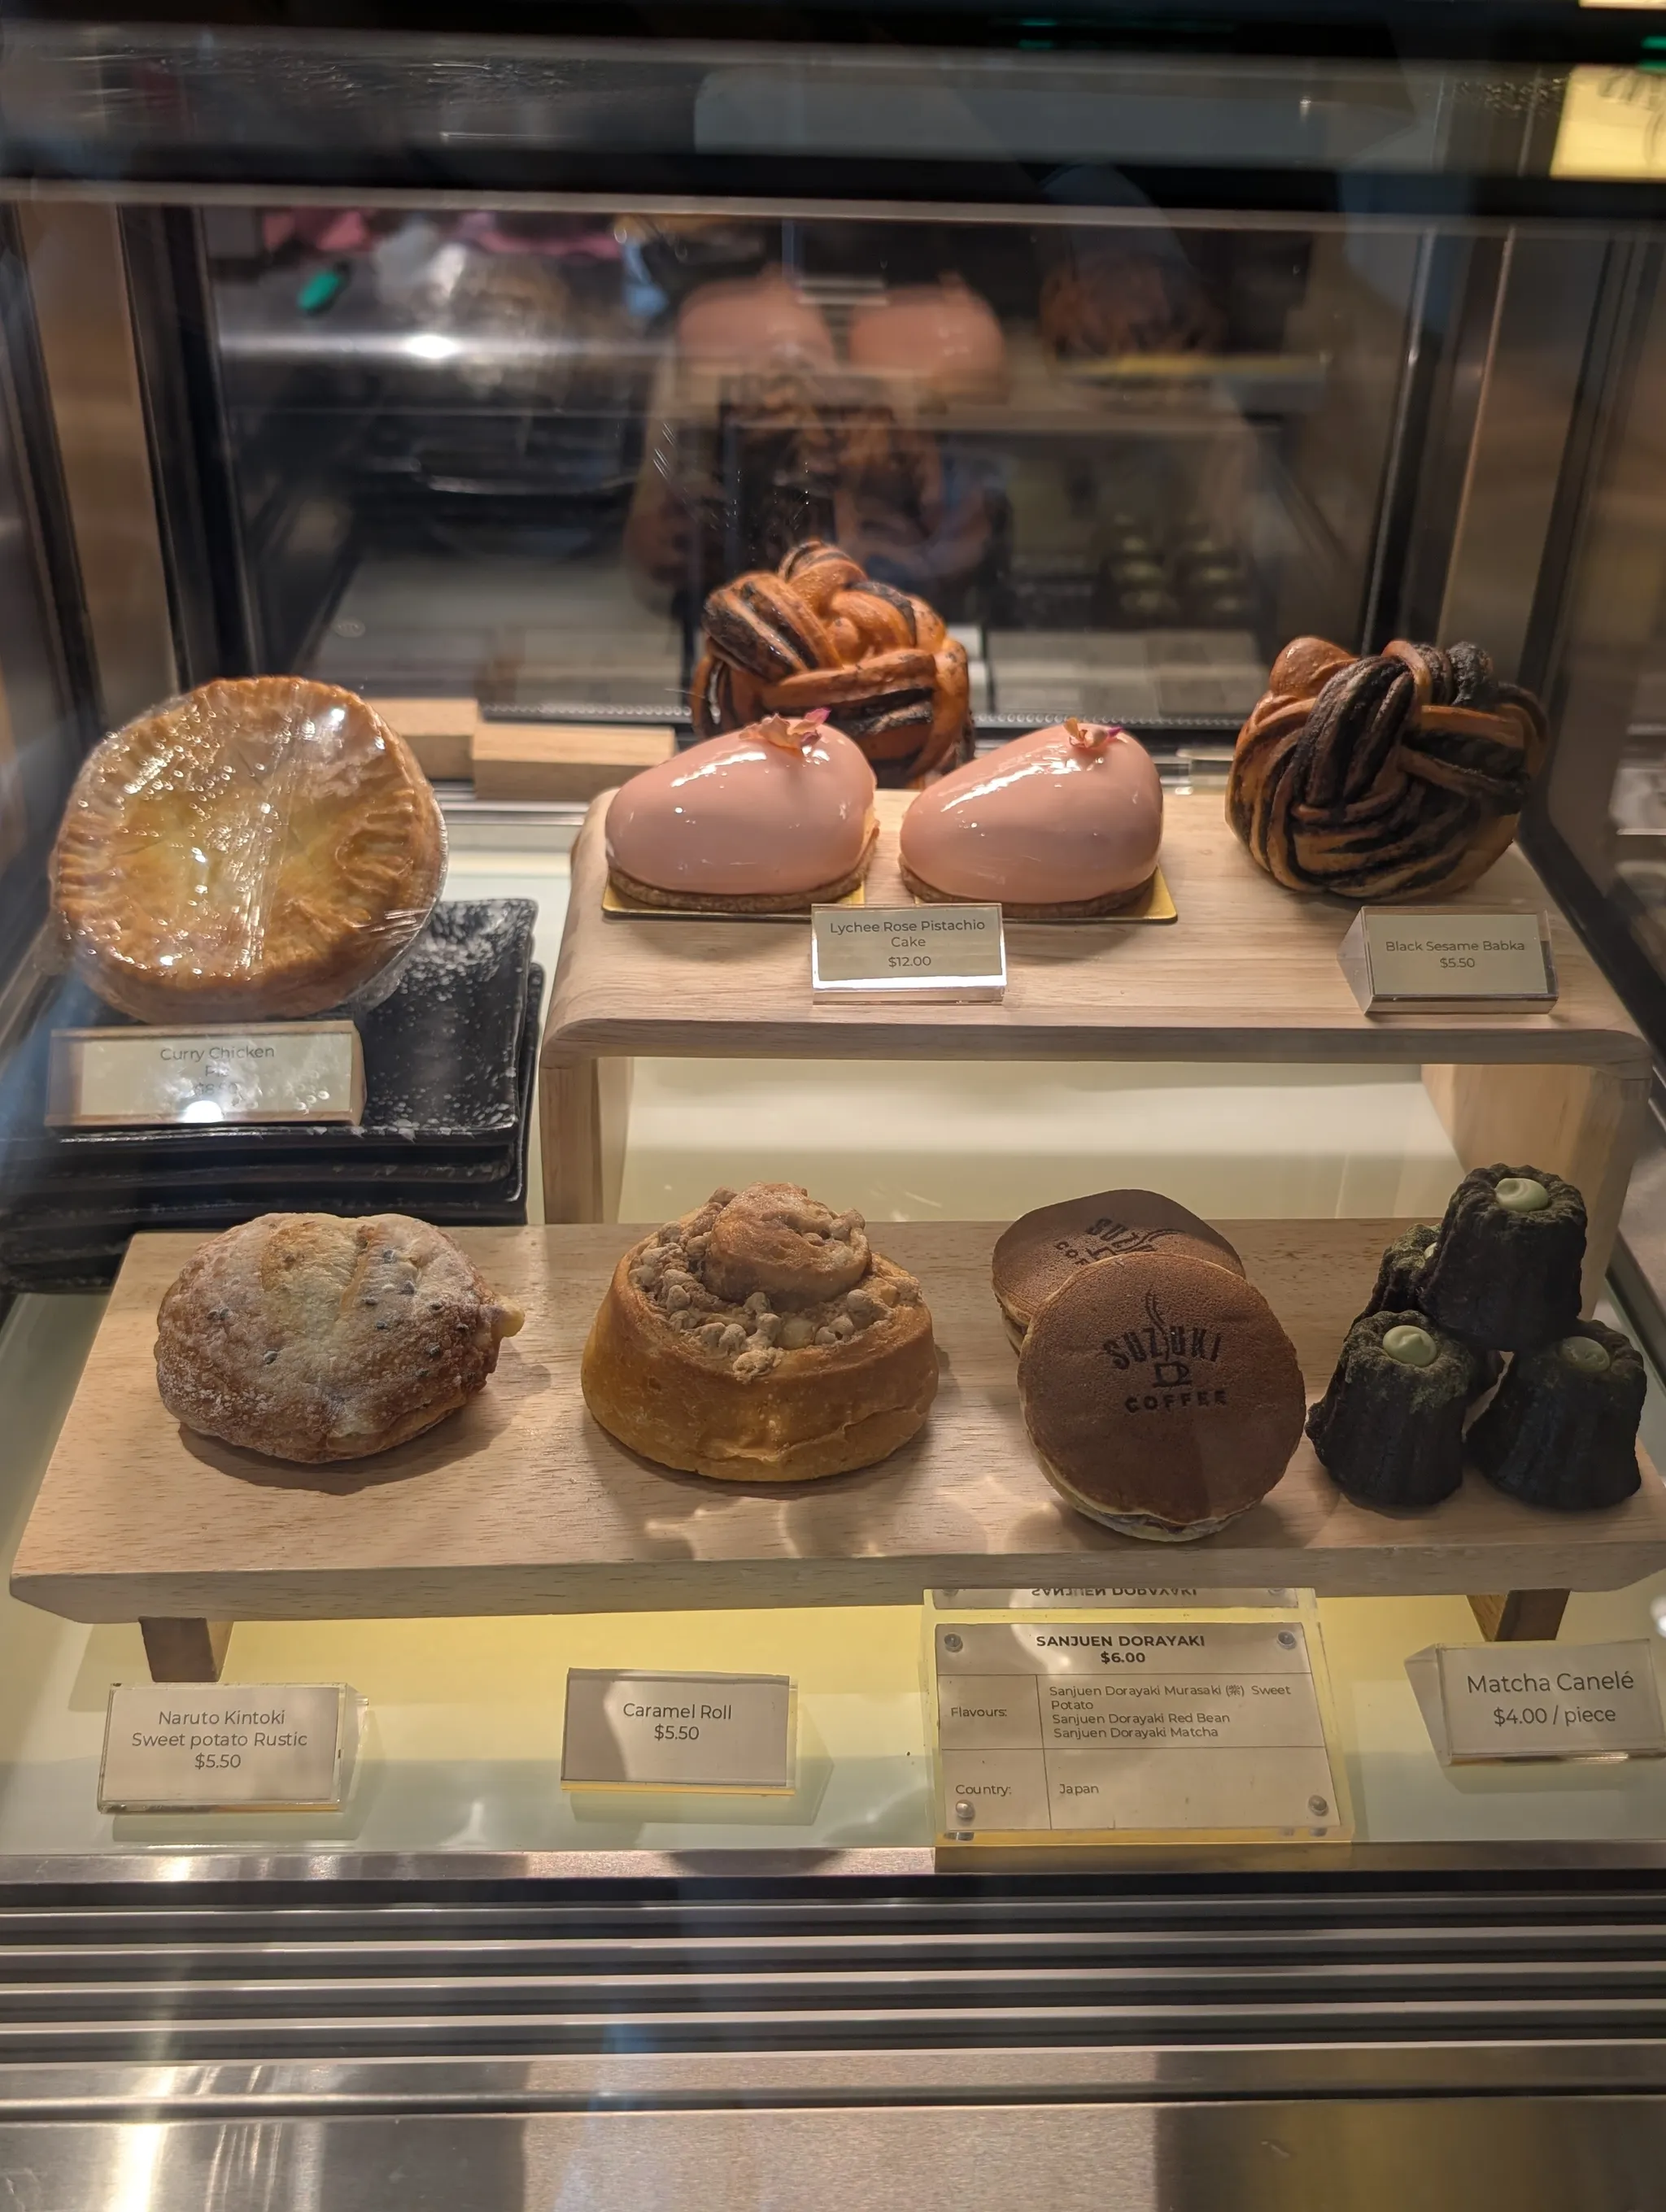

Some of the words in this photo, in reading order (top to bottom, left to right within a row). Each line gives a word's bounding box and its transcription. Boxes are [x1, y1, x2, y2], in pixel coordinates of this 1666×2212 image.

[830, 922, 880, 935] Lychee
[883, 921, 917, 932] Rose
[921, 919, 985, 931] Pistachio
[891, 937, 926, 947] Cake
[1385, 941, 1422, 951] Black
[1426, 941, 1479, 951] Sesame
[1483, 940, 1524, 951] Babka
[888, 956, 931, 968] $12.00
[1440, 957, 1475, 969] $5.50
[160, 1047, 204, 1062] Curry
[209, 1046, 274, 1059] Chicken
[1102, 1326, 1221, 1369] SUZUKI
[1125, 1391, 1228, 1413] COFFEE
[1036, 1636, 1113, 1647] SANJUEN
[1119, 1635, 1206, 1646] DORAYAKI
[1101, 1651, 1145, 1664] $6.00
[1467, 1673, 1550, 1693] Matcha
[1556, 1670, 1634, 1691] Canelé
[1049, 1686, 1101, 1697] Sanjuen
[1106, 1686, 1161, 1697] Dorayaki
[1164, 1685, 1221, 1696] Murasaki
[1251, 1685, 1291, 1695] Sweet
[1051, 1700, 1093, 1709] Potato
[159, 1711, 220, 1725] Naruto
[225, 1709, 285, 1725] Kintoki
[622, 1703, 696, 1718] Caramel
[700, 1705, 732, 1720] Roll
[951, 1706, 1007, 1717] Flavours:
[1494, 1707, 1547, 1726] $4.00
[1552, 1705, 1559, 1725] /
[1564, 1706, 1616, 1726] piece
[1053, 1714, 1105, 1726] Sanjuen
[1109, 1713, 1164, 1725] Dorayaki
[1168, 1713, 1193, 1722] Red
[1197, 1713, 1230, 1722] Bean
[654, 1723, 700, 1741] $5.50
[1053, 1728, 1106, 1740] Sanjuen
[1110, 1727, 1167, 1739] Dorayaki
[1171, 1726, 1218, 1737] Matcha
[132, 1732, 185, 1747] Sweet
[190, 1732, 248, 1748] potato
[254, 1731, 307, 1746] Rustic
[194, 1753, 242, 1770] $5.50
[955, 1784, 1012, 1796] Country:
[1059, 1784, 1099, 1796] Japan
